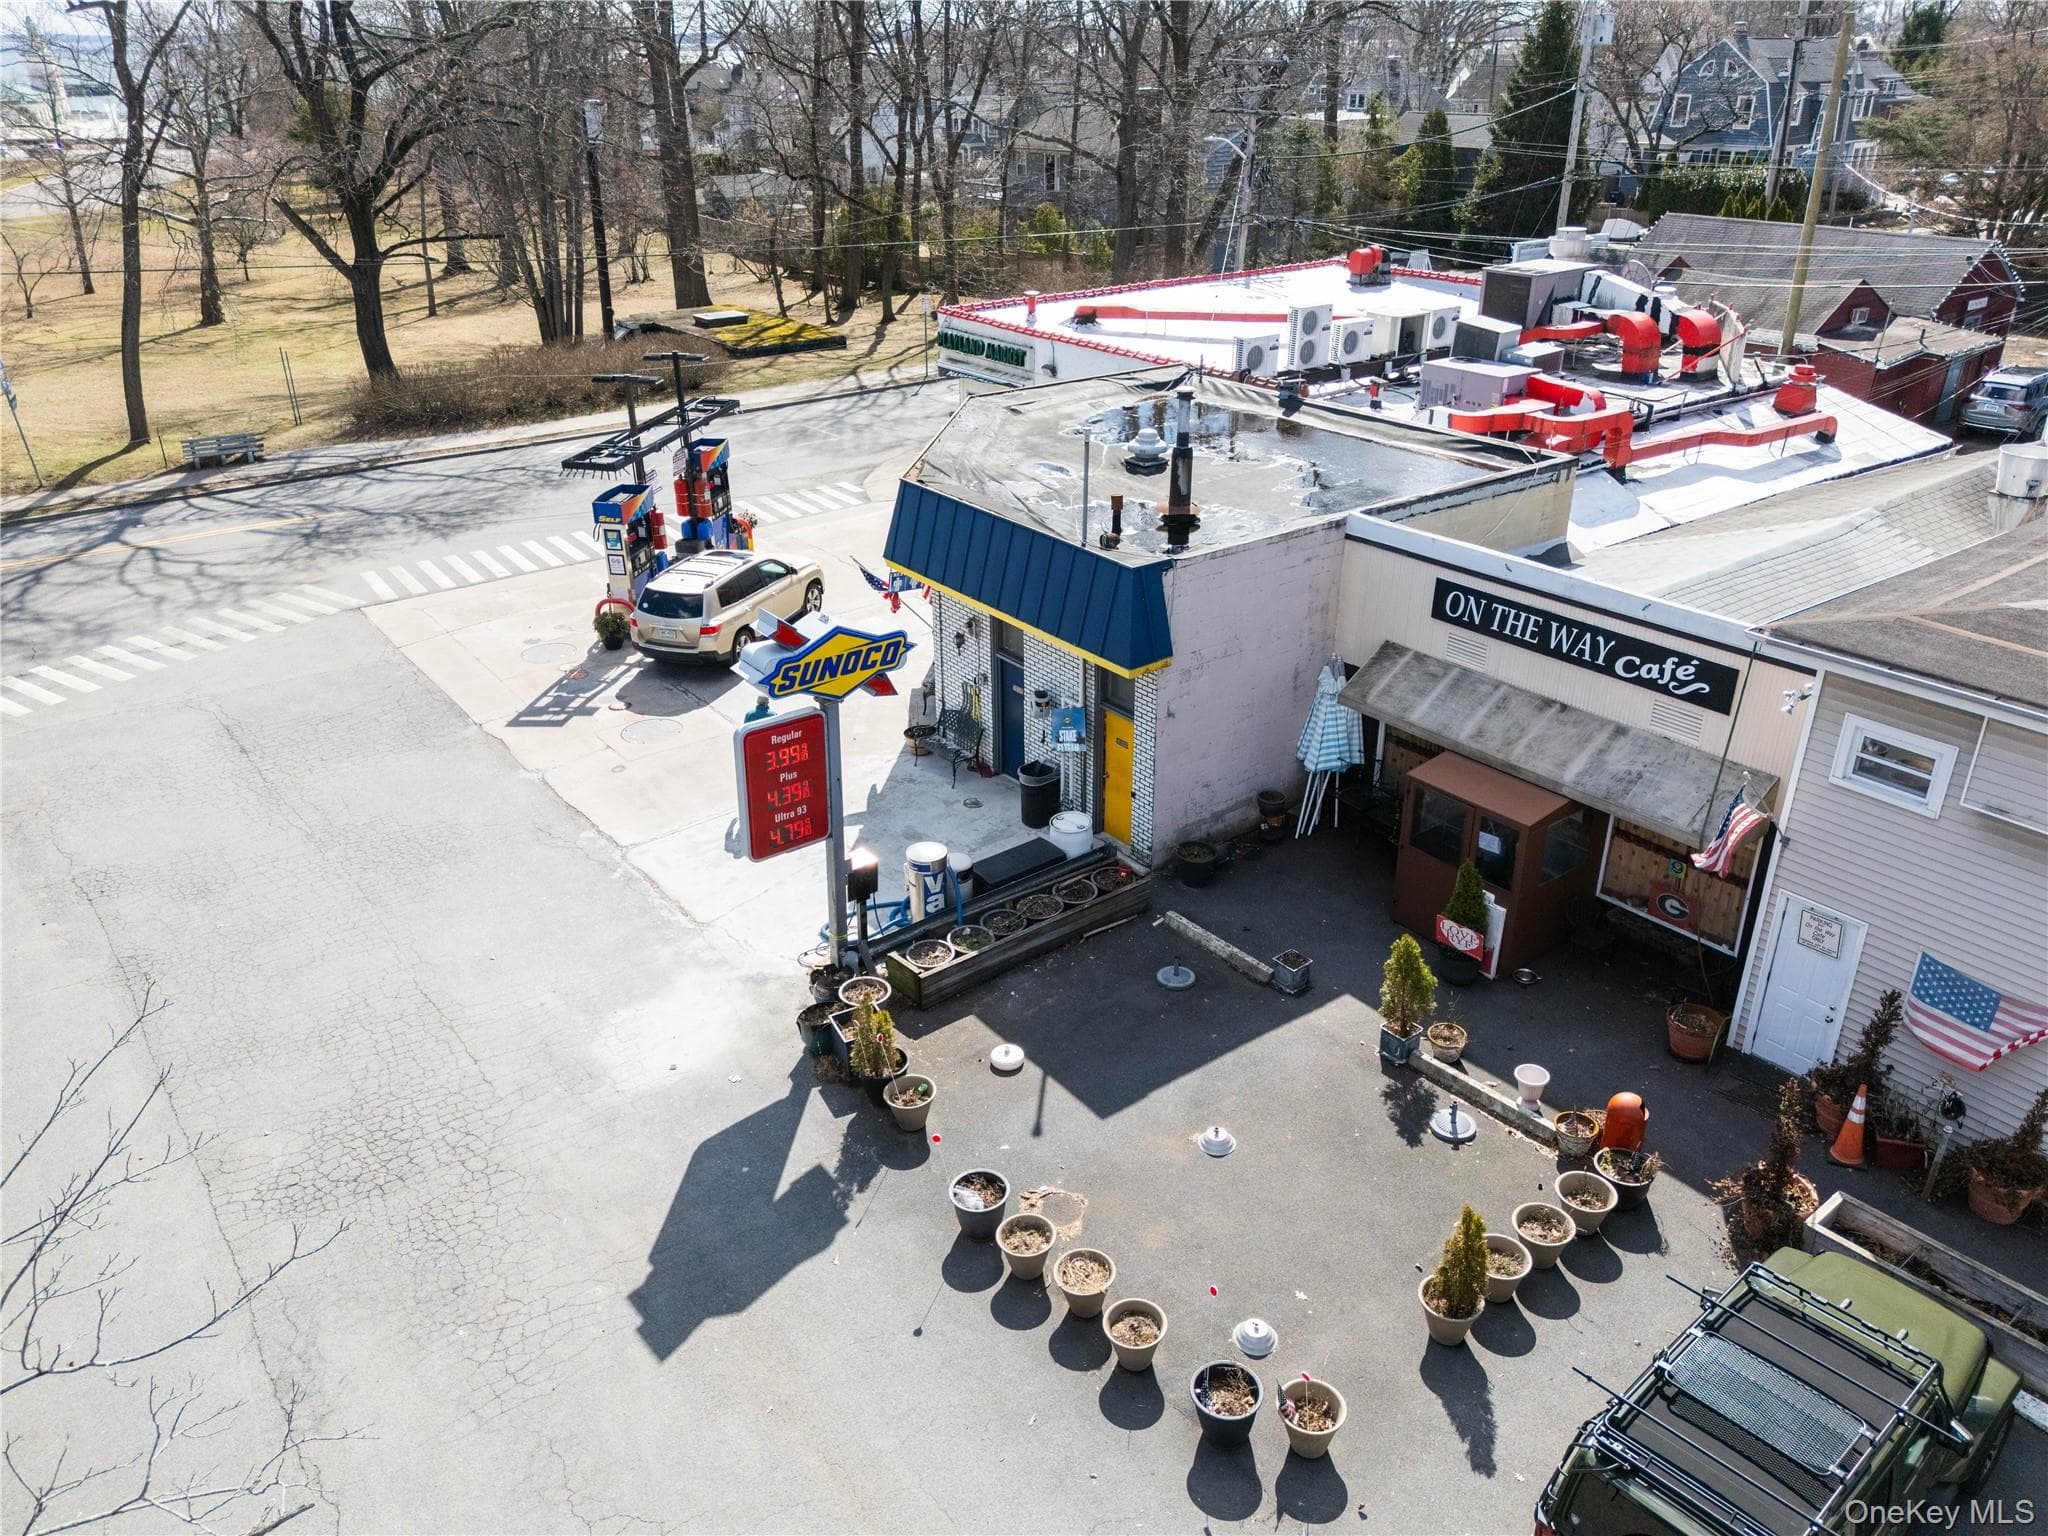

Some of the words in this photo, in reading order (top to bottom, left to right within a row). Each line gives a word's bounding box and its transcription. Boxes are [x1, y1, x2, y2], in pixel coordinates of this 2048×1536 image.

[985, 342, 1027, 367] MARKET
[1445, 591, 1487, 625] ON
[1489, 603, 1543, 644] THE
[1549, 621, 1616, 666] WAY
[1614, 656, 1711, 695] Café
[777, 640, 902, 692] SUNOCO
[771, 730, 802, 745] Regular
[780, 771, 798, 782] Plus
[774, 810, 795, 823] Ultra
[797, 805, 807, 816] 93
[1441, 921, 1478, 946] LOVE
